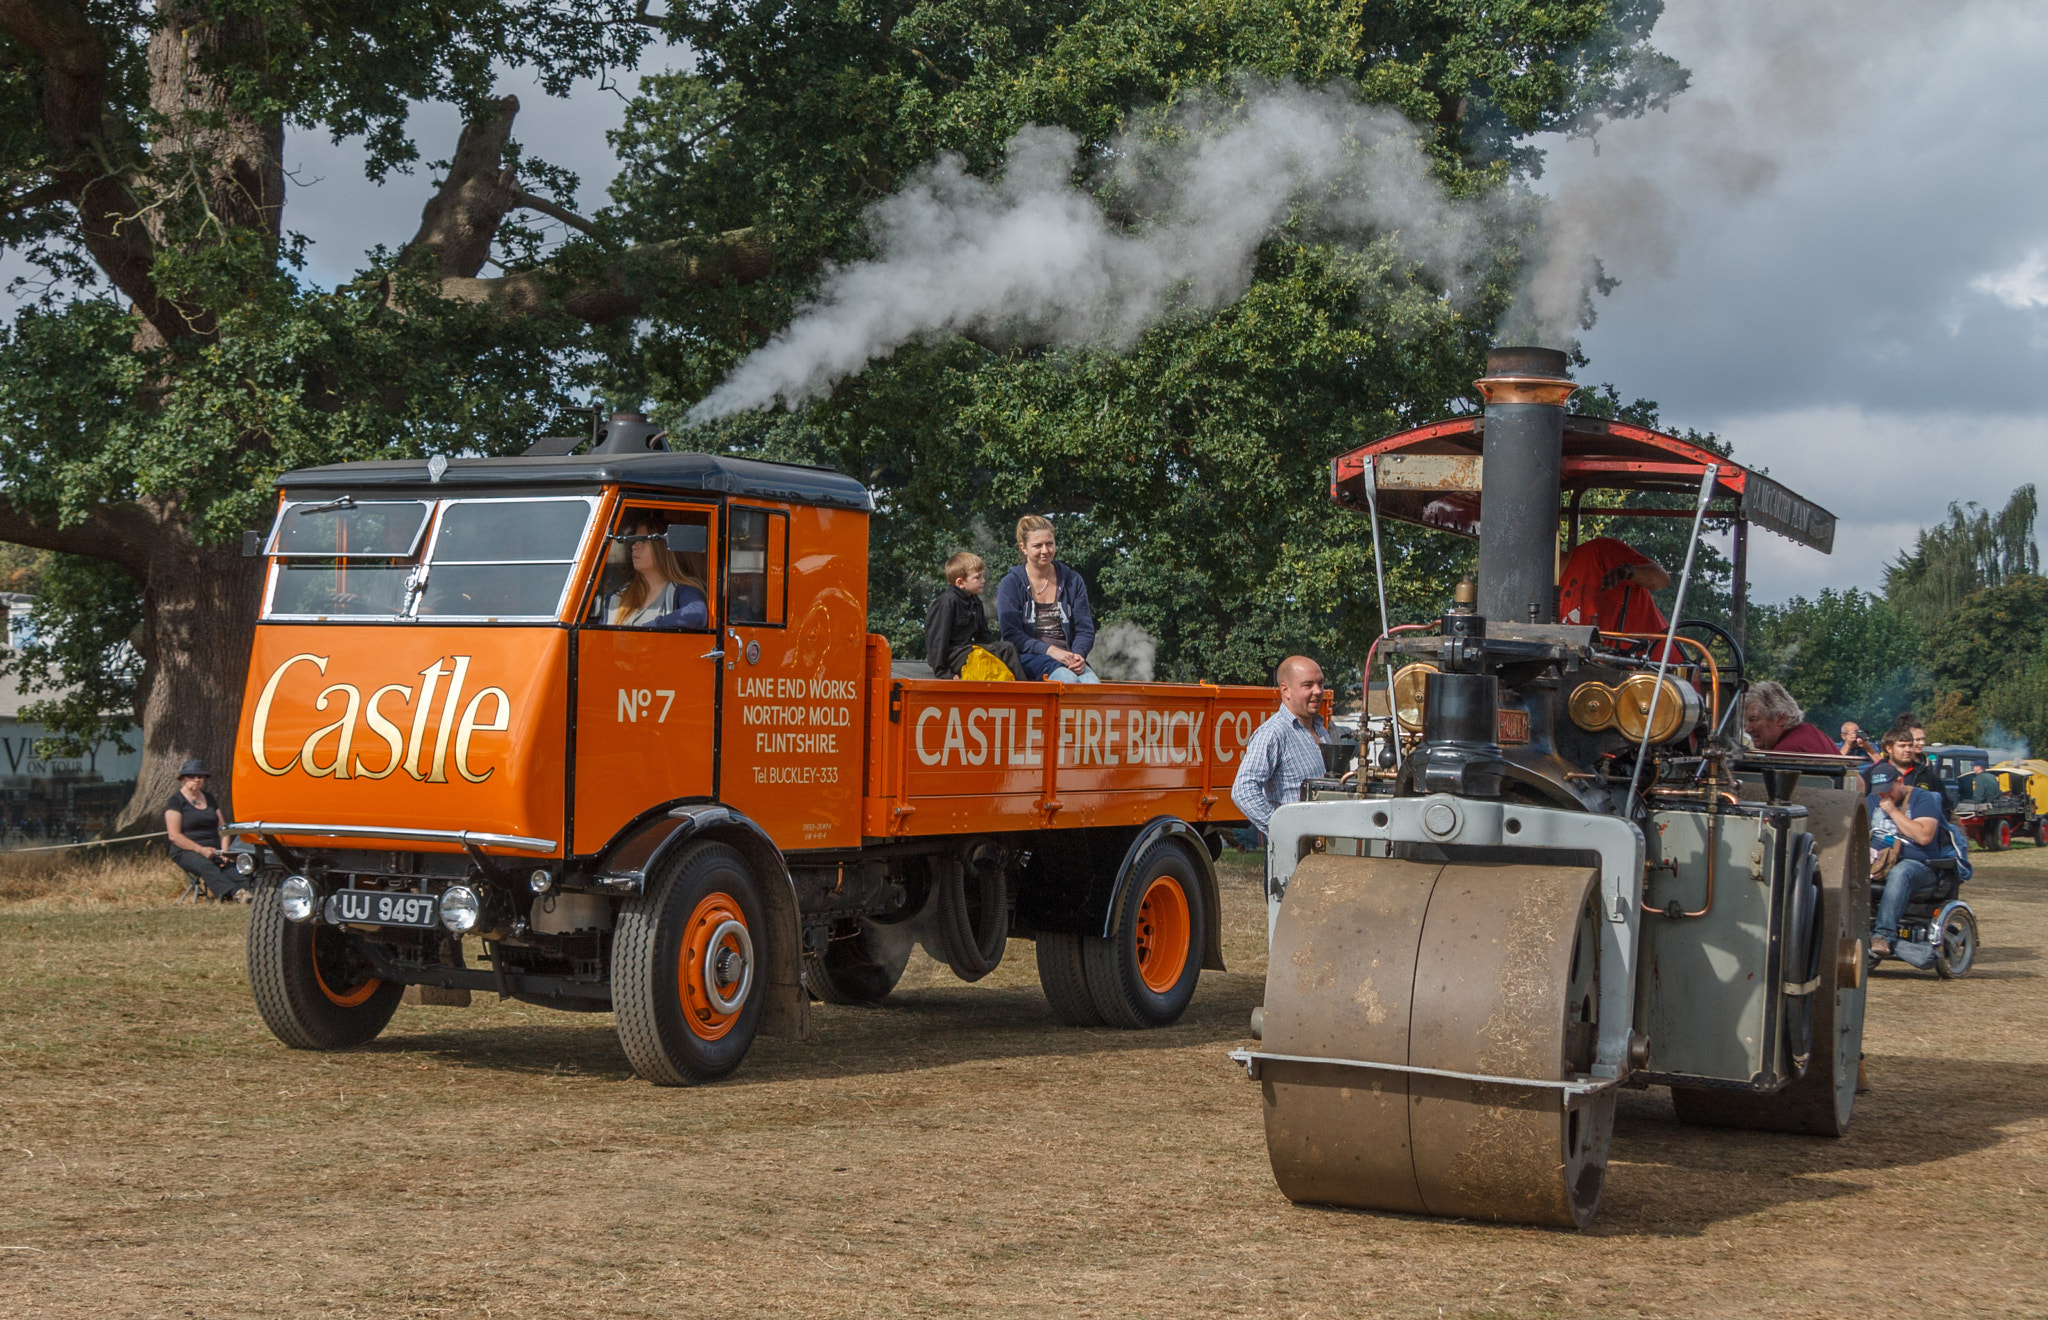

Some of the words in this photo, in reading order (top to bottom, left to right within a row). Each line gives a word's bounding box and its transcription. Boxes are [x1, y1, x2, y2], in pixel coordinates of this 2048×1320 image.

[737, 677, 774, 698] LANE
[777, 678, 806, 699] END
[251, 653, 511, 784] Castle
[915, 706, 1043, 766] CASTLE
[1058, 708, 1121, 765] FIRE
[1126, 709, 1205, 764] BRICK
[769, 767, 839, 784] BUCKLEY-333
[342, 894, 371, 920] UJ
[378, 897, 433, 924] 9497
